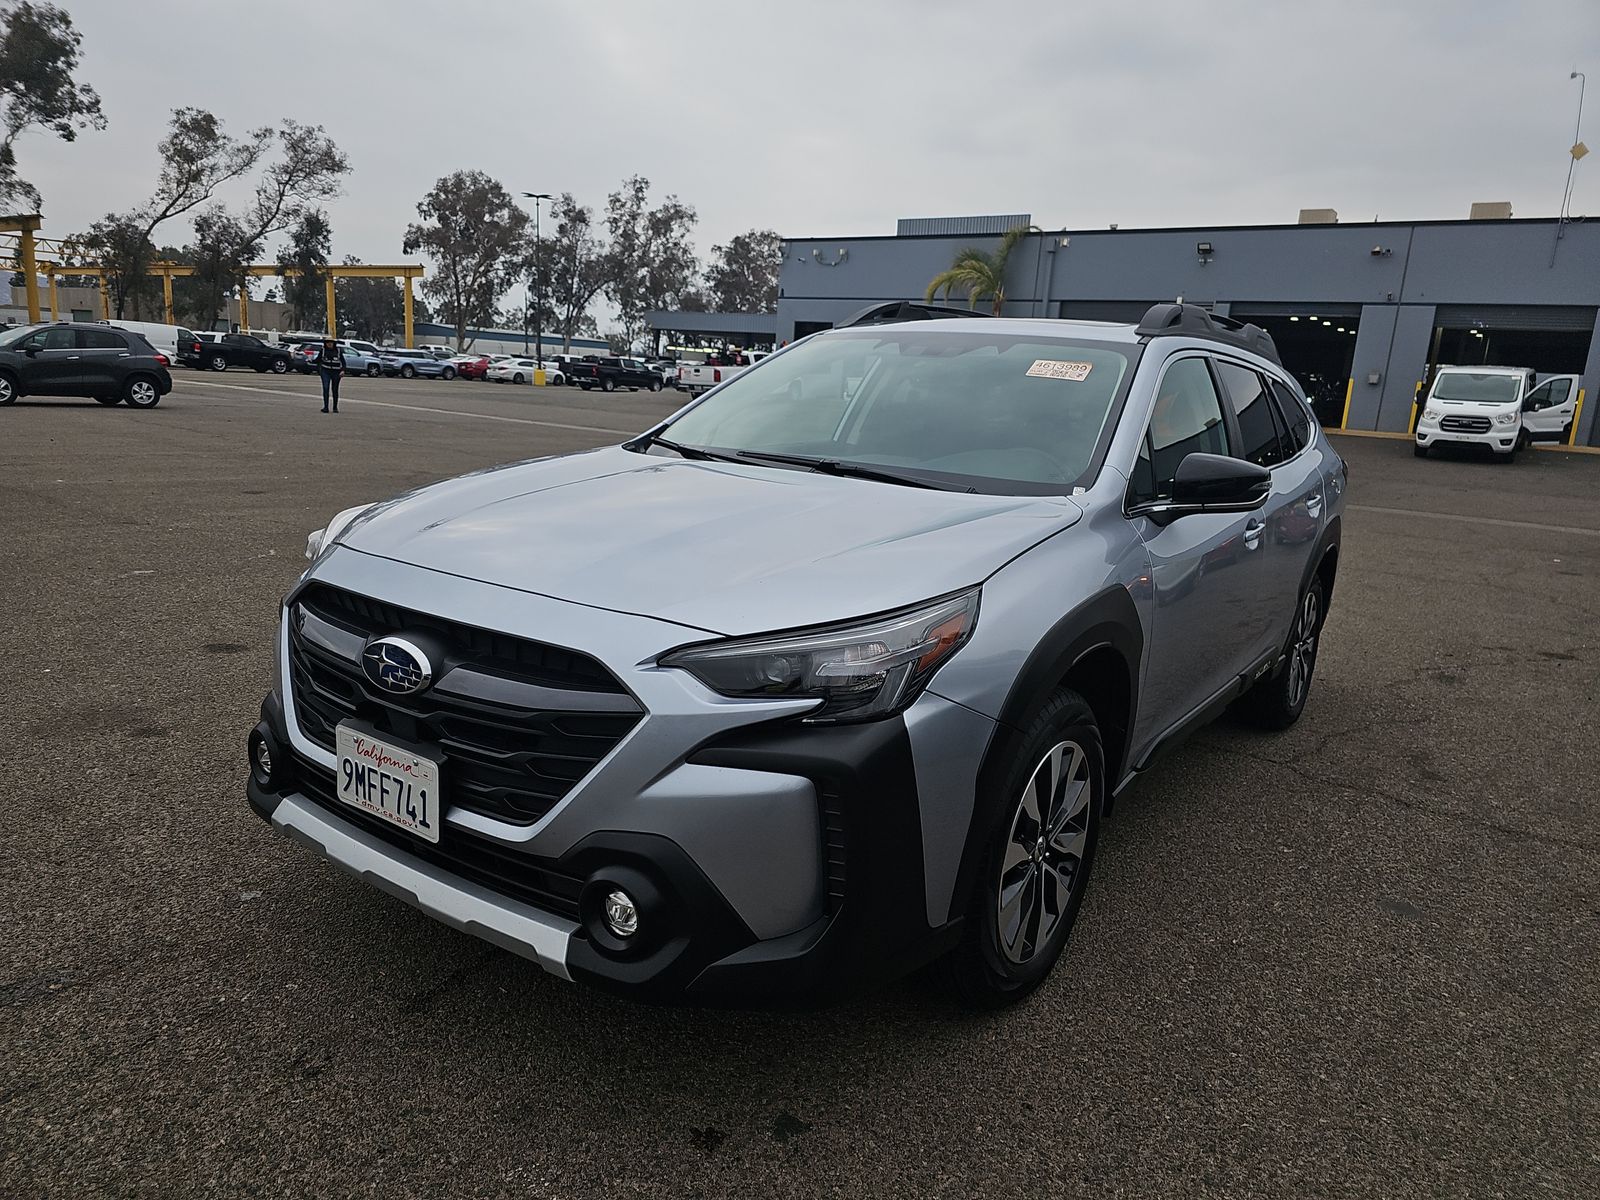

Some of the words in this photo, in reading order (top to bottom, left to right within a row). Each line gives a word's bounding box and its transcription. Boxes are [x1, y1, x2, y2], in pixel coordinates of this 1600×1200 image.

[356, 738, 419, 777] California
[342, 757, 431, 829] 9MFF741
[361, 800, 413, 827] dmv.ca.gov
